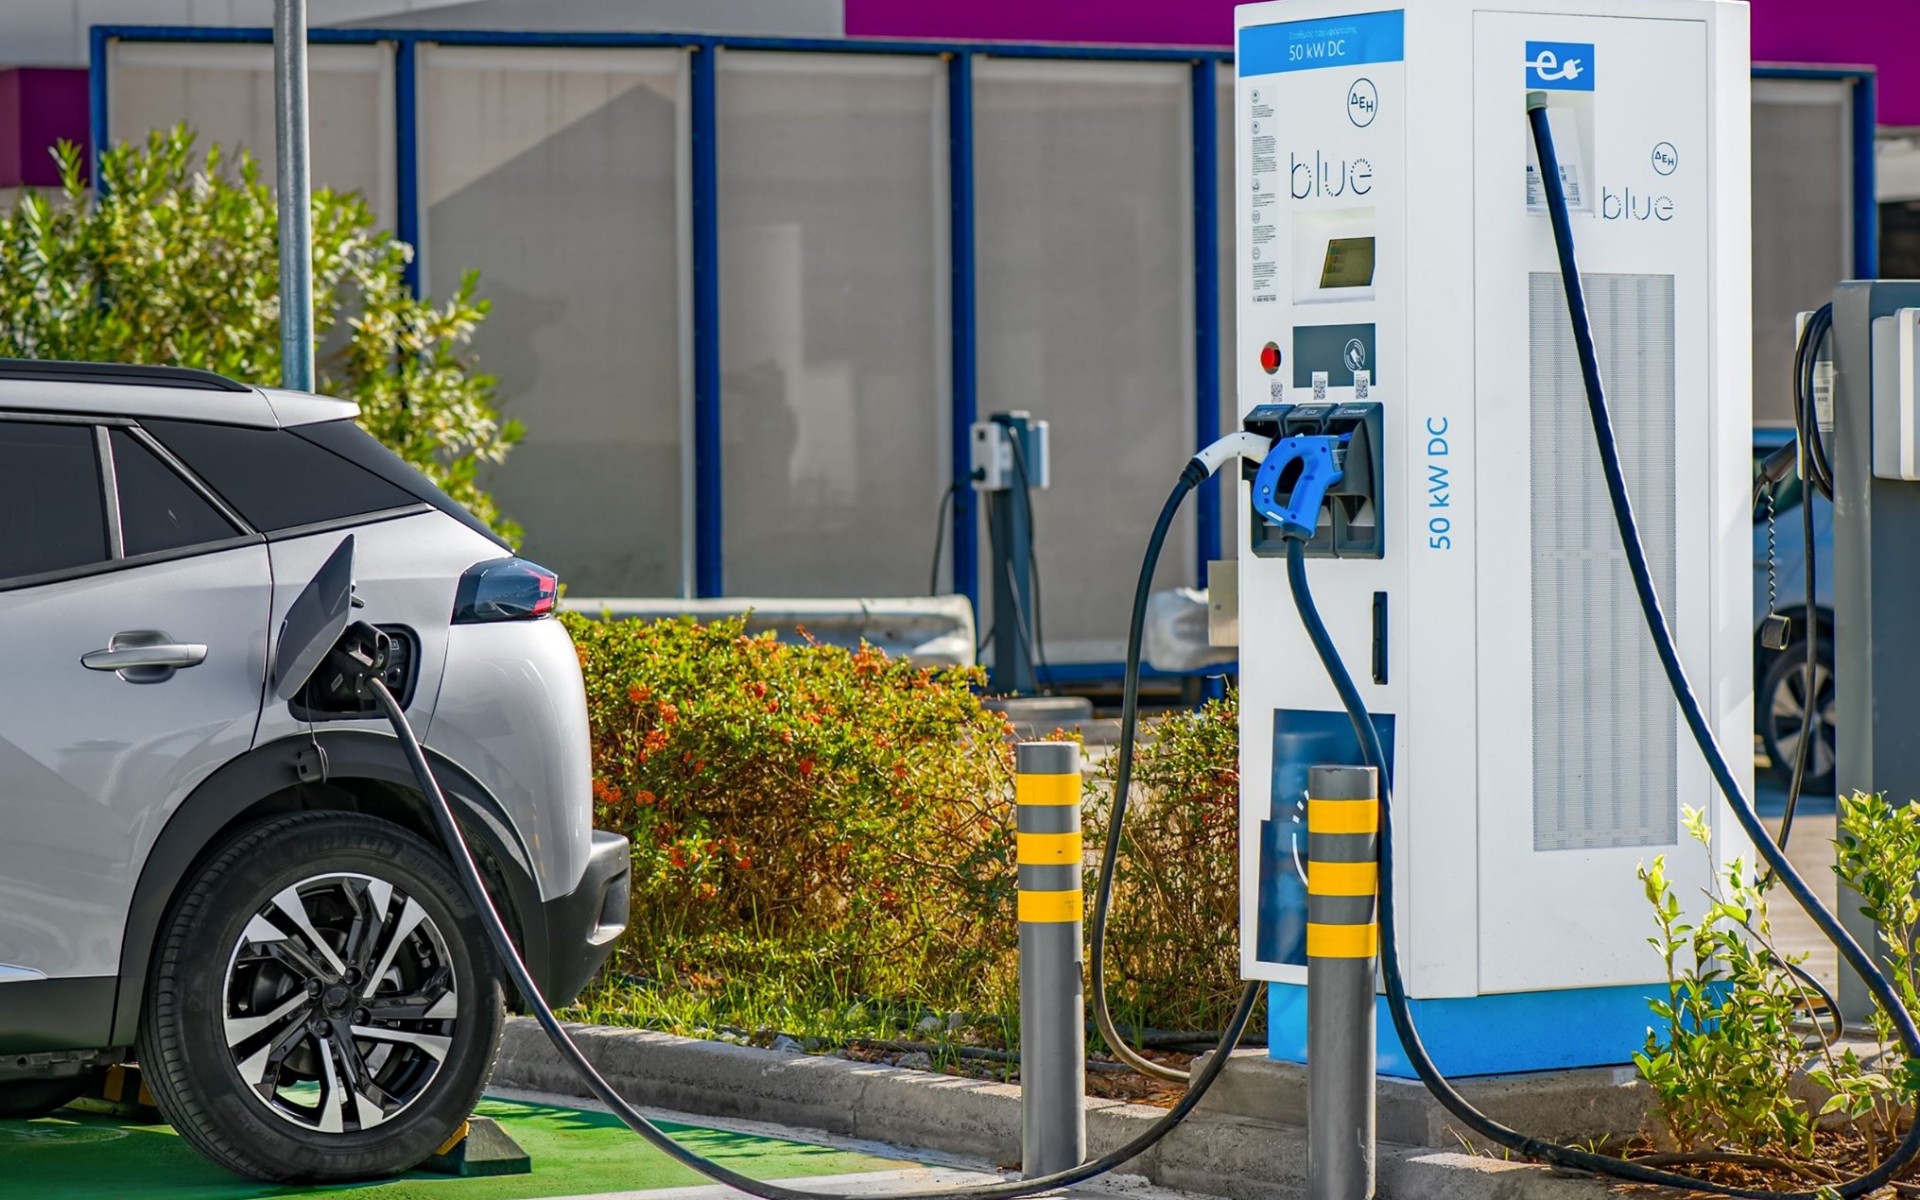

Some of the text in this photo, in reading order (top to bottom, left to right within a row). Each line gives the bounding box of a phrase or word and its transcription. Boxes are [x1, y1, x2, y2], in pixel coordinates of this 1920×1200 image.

[1289, 39, 1346, 61] 50 kW DC
[1291, 149, 1373, 200] blue
[1602, 185, 1674, 222] blue
[1426, 416, 1451, 550] 50 kW DC
